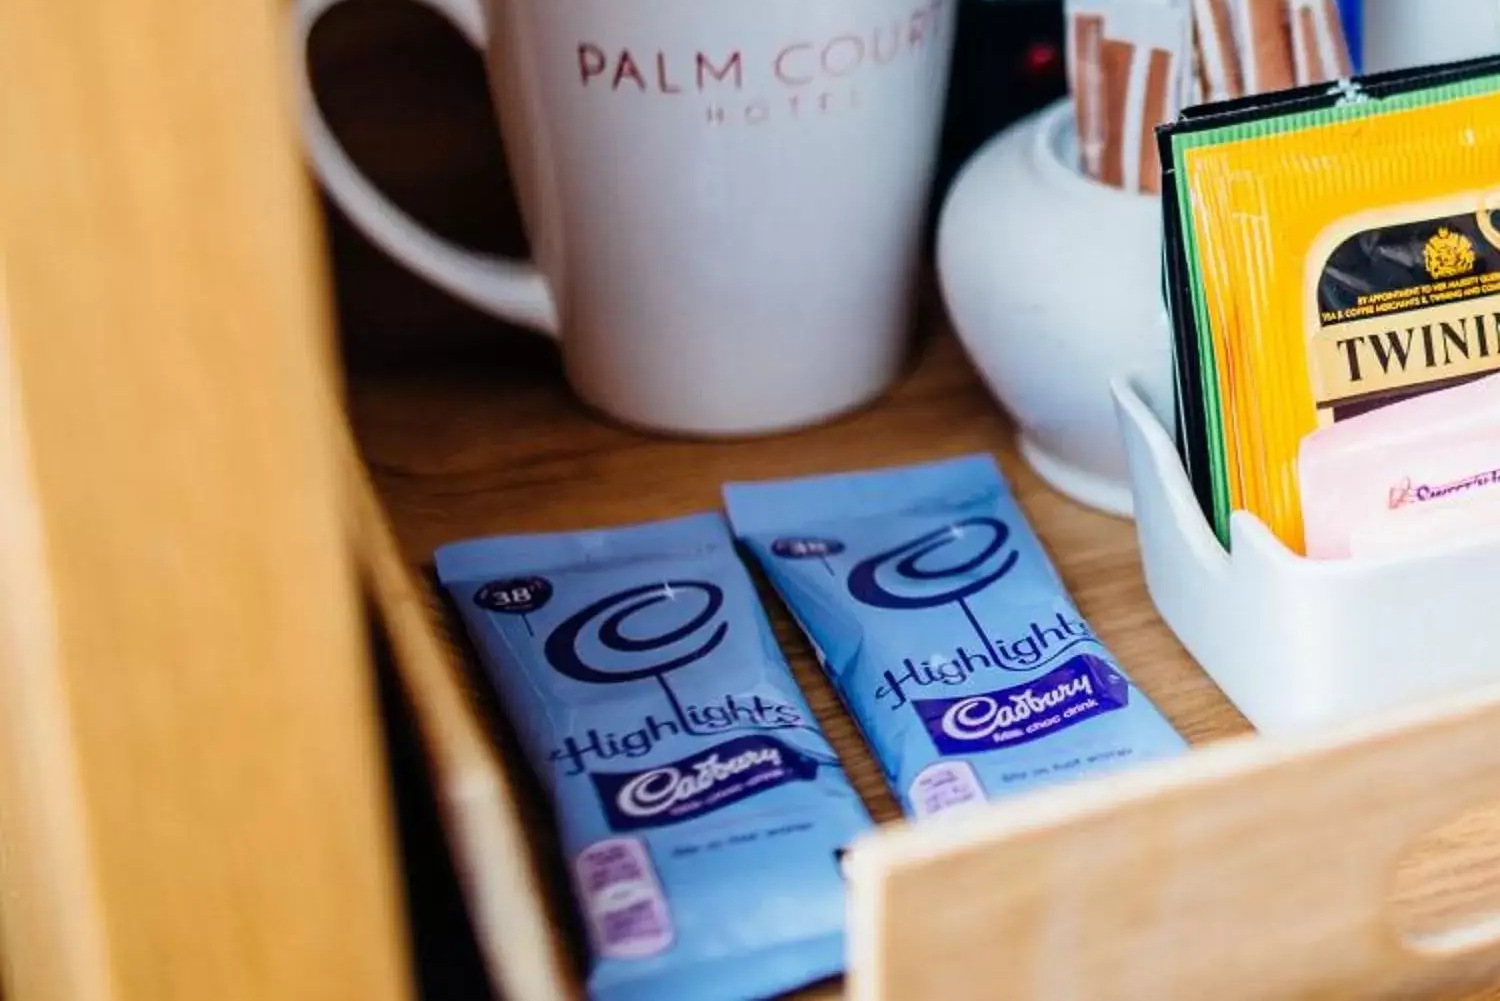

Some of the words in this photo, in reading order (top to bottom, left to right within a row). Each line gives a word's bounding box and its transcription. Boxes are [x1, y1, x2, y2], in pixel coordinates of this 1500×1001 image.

[576, 41, 743, 95] PALM
[547, 693, 803, 777] Highlights
[941, 674, 1094, 741] Cadbury
[616, 747, 783, 818] Cadbury
